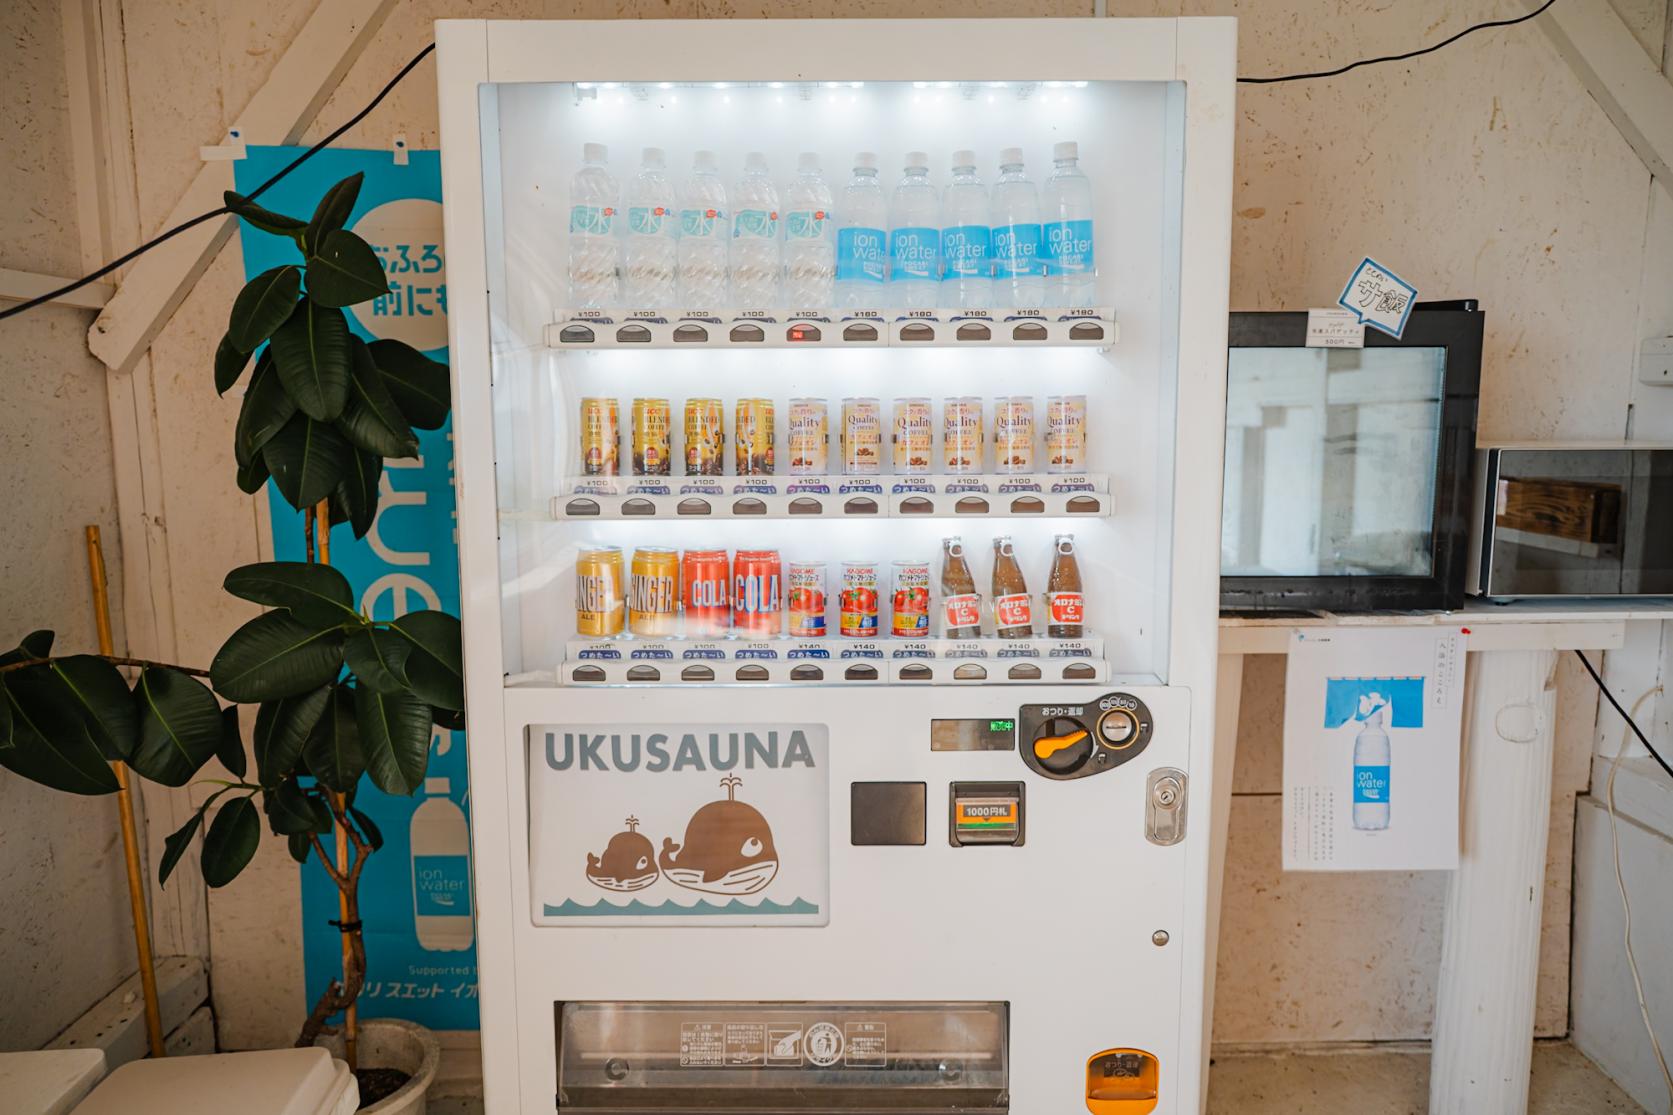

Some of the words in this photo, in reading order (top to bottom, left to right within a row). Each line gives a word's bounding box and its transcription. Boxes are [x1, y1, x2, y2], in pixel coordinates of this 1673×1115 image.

[853, 231, 878, 247] ion
[895, 231, 919, 247] ion
[944, 231, 966, 247] ion
[995, 231, 1016, 246] ion
[1049, 226, 1073, 242] ion
[895, 244, 937, 260] water
[945, 243, 987, 260] water
[996, 241, 1037, 257] water
[1049, 238, 1091, 255] water
[847, 414, 878, 426] Quality
[996, 415, 1032, 428] Quality
[692, 578, 727, 608] COLA
[735, 574, 780, 614] COLA
[960, 607, 968, 616] C
[1013, 607, 1022, 615] C
[1066, 605, 1075, 613] C
[545, 730, 816, 773] UKUSAUNA
[966, 806, 1008, 817] 1000円札
[419, 868, 443, 880] ion
[419, 879, 465, 891] water
[408, 965, 470, 977] Supported
[386, 982, 444, 998] スエット
